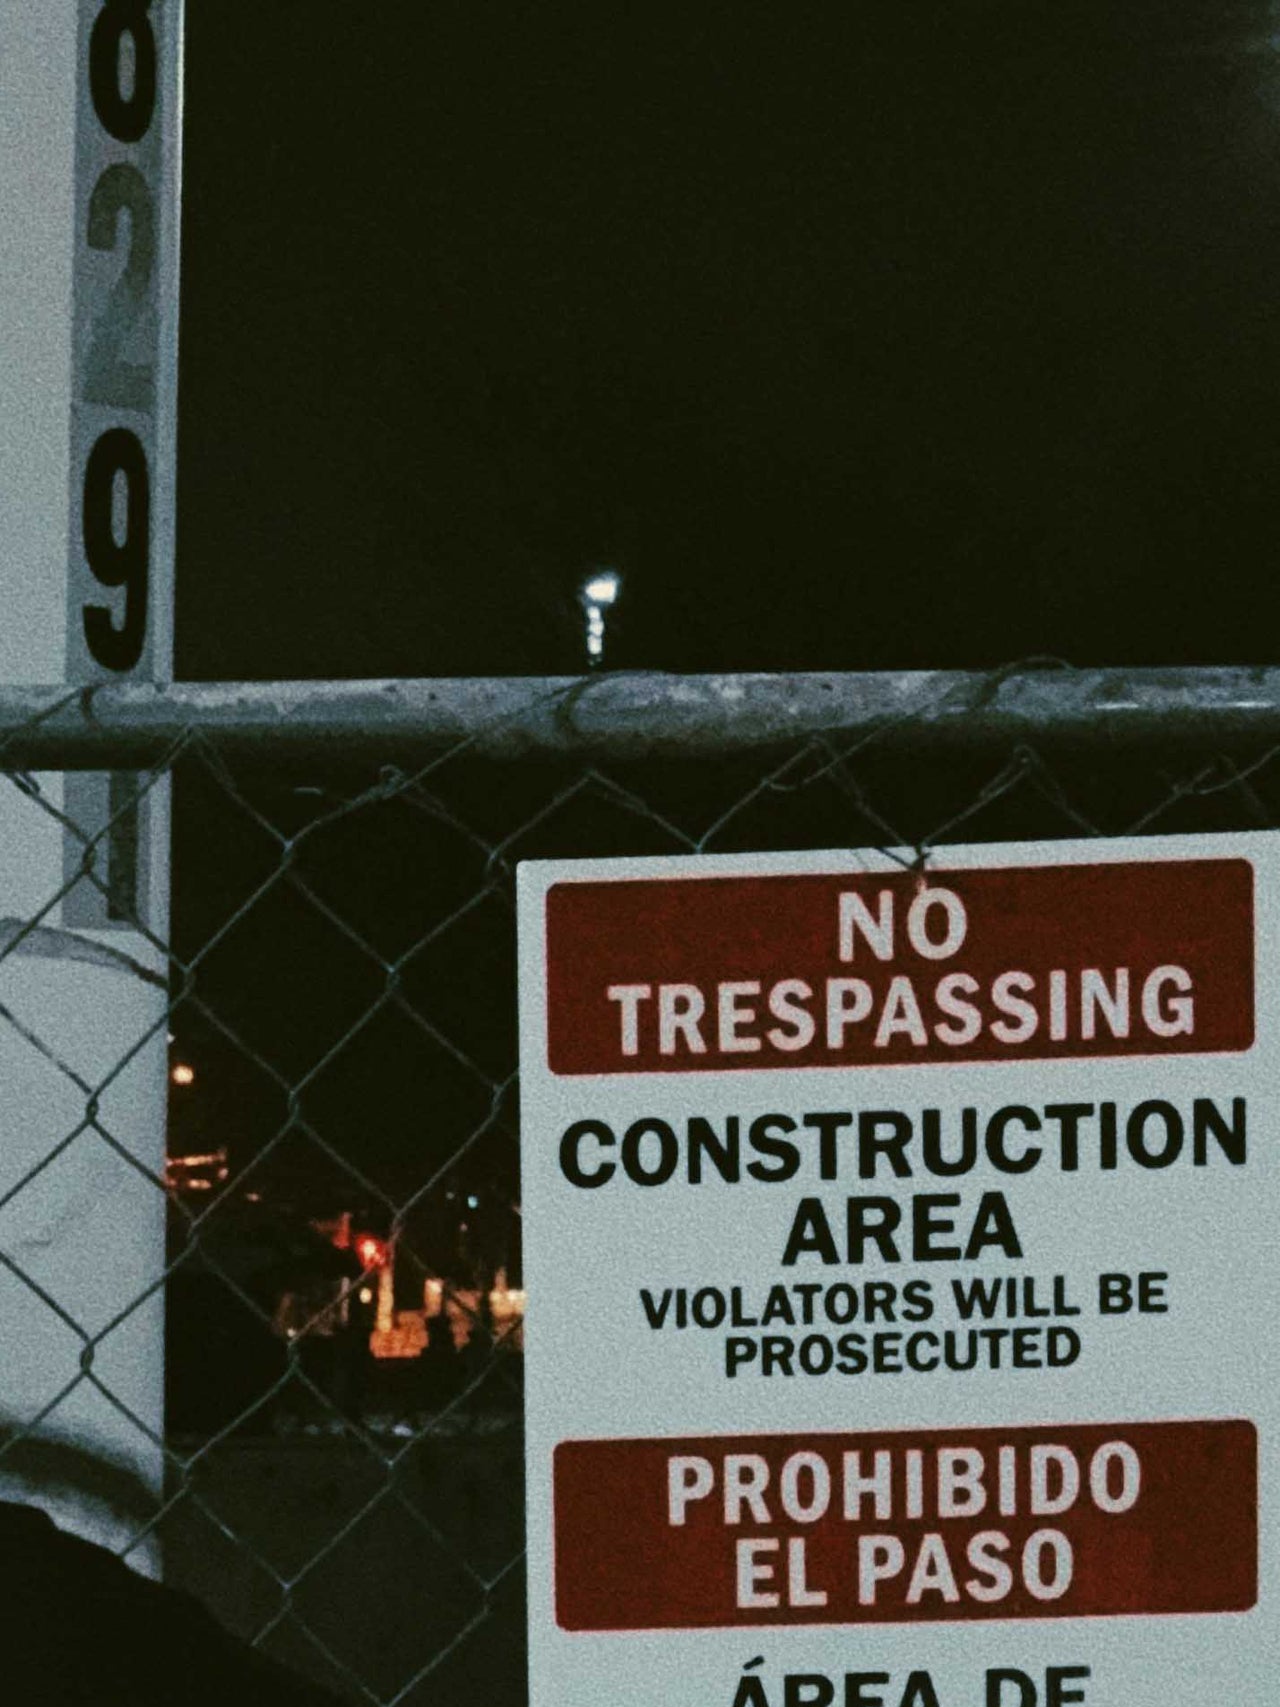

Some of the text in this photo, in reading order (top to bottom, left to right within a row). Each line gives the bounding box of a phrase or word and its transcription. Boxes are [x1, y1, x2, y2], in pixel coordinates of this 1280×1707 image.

[838, 887, 967, 962] NO
[607, 965, 1195, 1055] TRESPASSING
[559, 1097, 1246, 1188] CONSTRUCTION
[782, 1192, 1023, 1266] AREA
[640, 1272, 1168, 1329] VIOLATORS WILL BE
[726, 1327, 1081, 1378] PROSECUTED
[668, 1441, 1140, 1525] PROHIBIDO
[737, 1529, 1073, 1608] EL PASO
